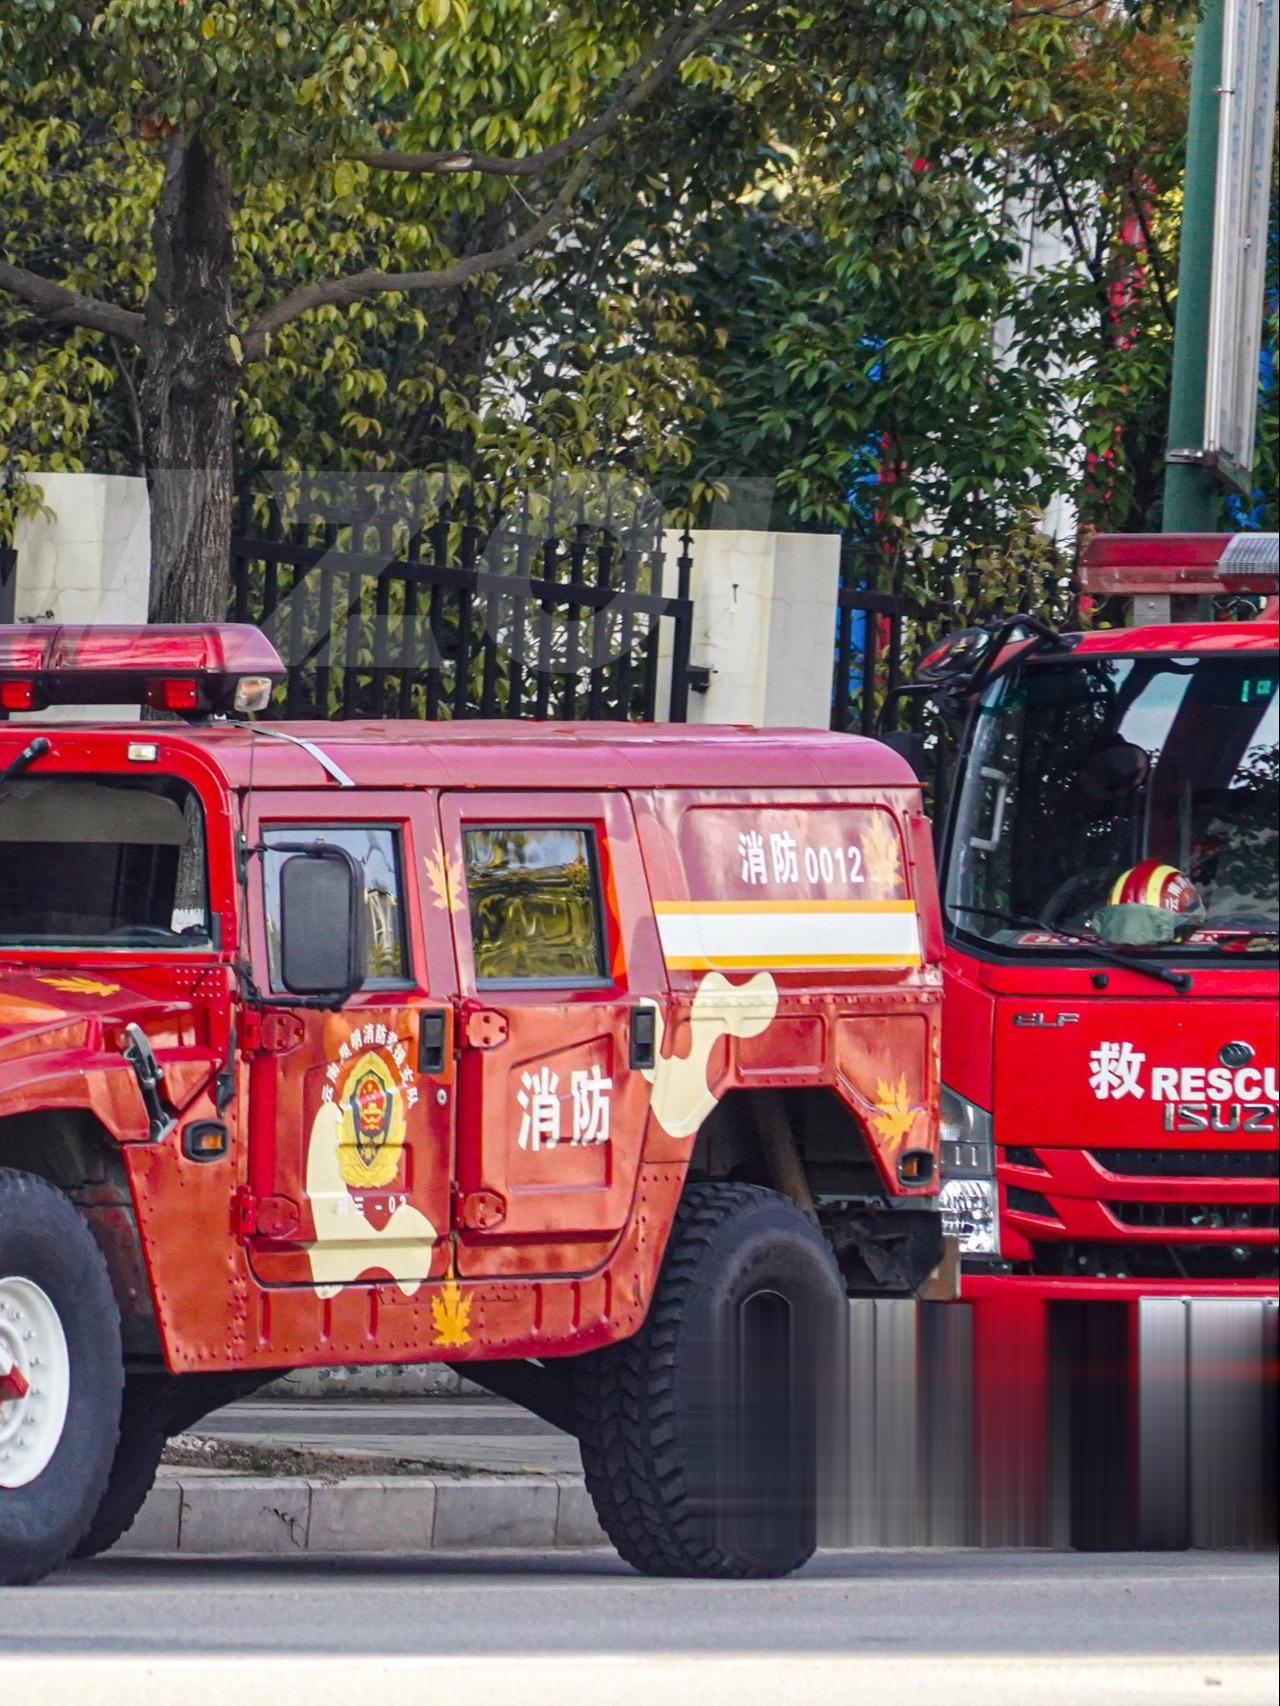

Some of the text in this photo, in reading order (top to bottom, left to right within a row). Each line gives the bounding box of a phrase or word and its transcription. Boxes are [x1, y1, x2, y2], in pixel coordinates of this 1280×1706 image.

[737, 830, 864, 885] 消防 0012
[1014, 1012, 1080, 1027] ELF
[1089, 1041, 1146, 1100] 救
[516, 1065, 613, 1152] 消防
[1165, 1103, 1279, 1132] ISUZ
